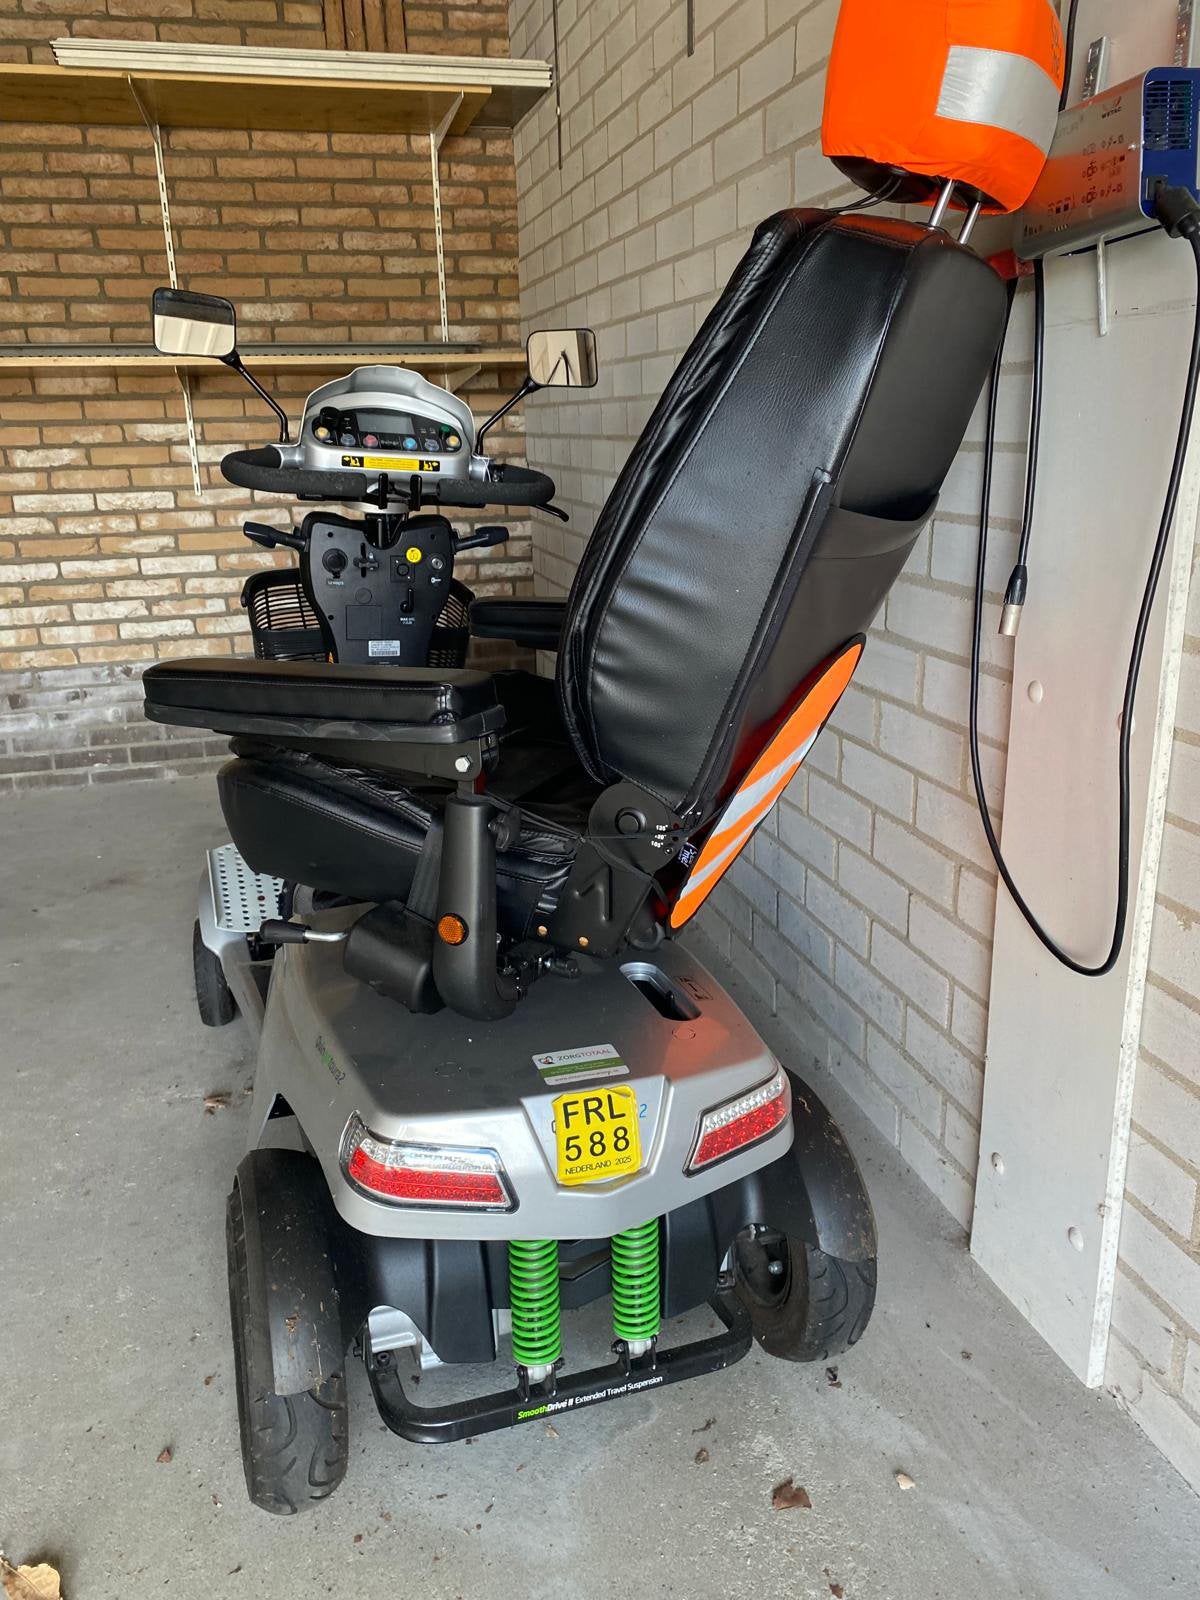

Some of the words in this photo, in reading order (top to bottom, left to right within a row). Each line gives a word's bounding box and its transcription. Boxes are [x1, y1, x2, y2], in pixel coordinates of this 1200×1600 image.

[563, 1094, 626, 1129] FRL
[639, 1103, 648, 1118] 2
[565, 1126, 630, 1161] 588
[565, 1160, 612, 1175] NEDERLAND
[615, 1156, 632, 1166] 2025
[575, 1390, 606, 1404] Extended
[607, 1384, 627, 1396] Travel
[627, 1376, 663, 1391] Suspension
